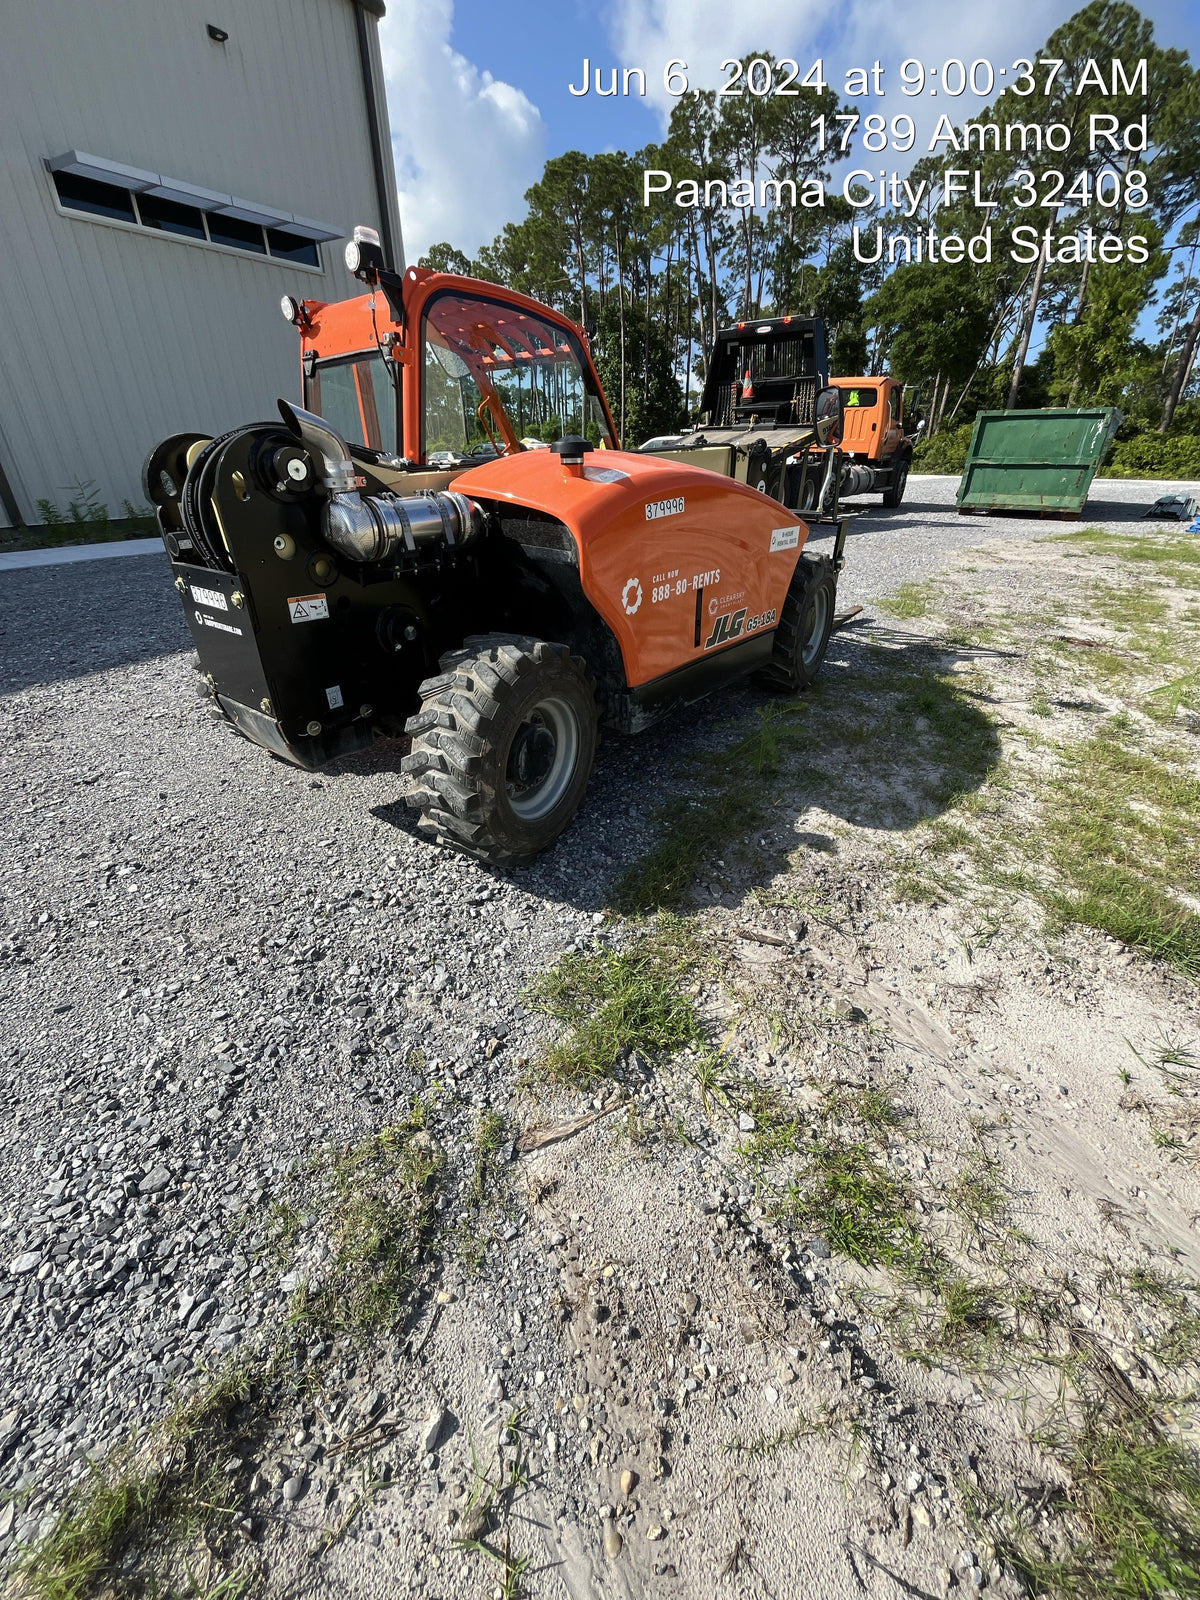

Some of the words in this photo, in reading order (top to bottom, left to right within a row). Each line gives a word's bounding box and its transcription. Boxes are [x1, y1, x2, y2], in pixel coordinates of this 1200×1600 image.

[645, 497, 685, 520] 379996
[651, 568, 721, 604] 888-80-RENTS
[652, 573, 666, 584] CALL
[667, 569, 680, 579] NOW
[190, 585, 228, 611] 379996
[704, 606, 749, 651] JLG
